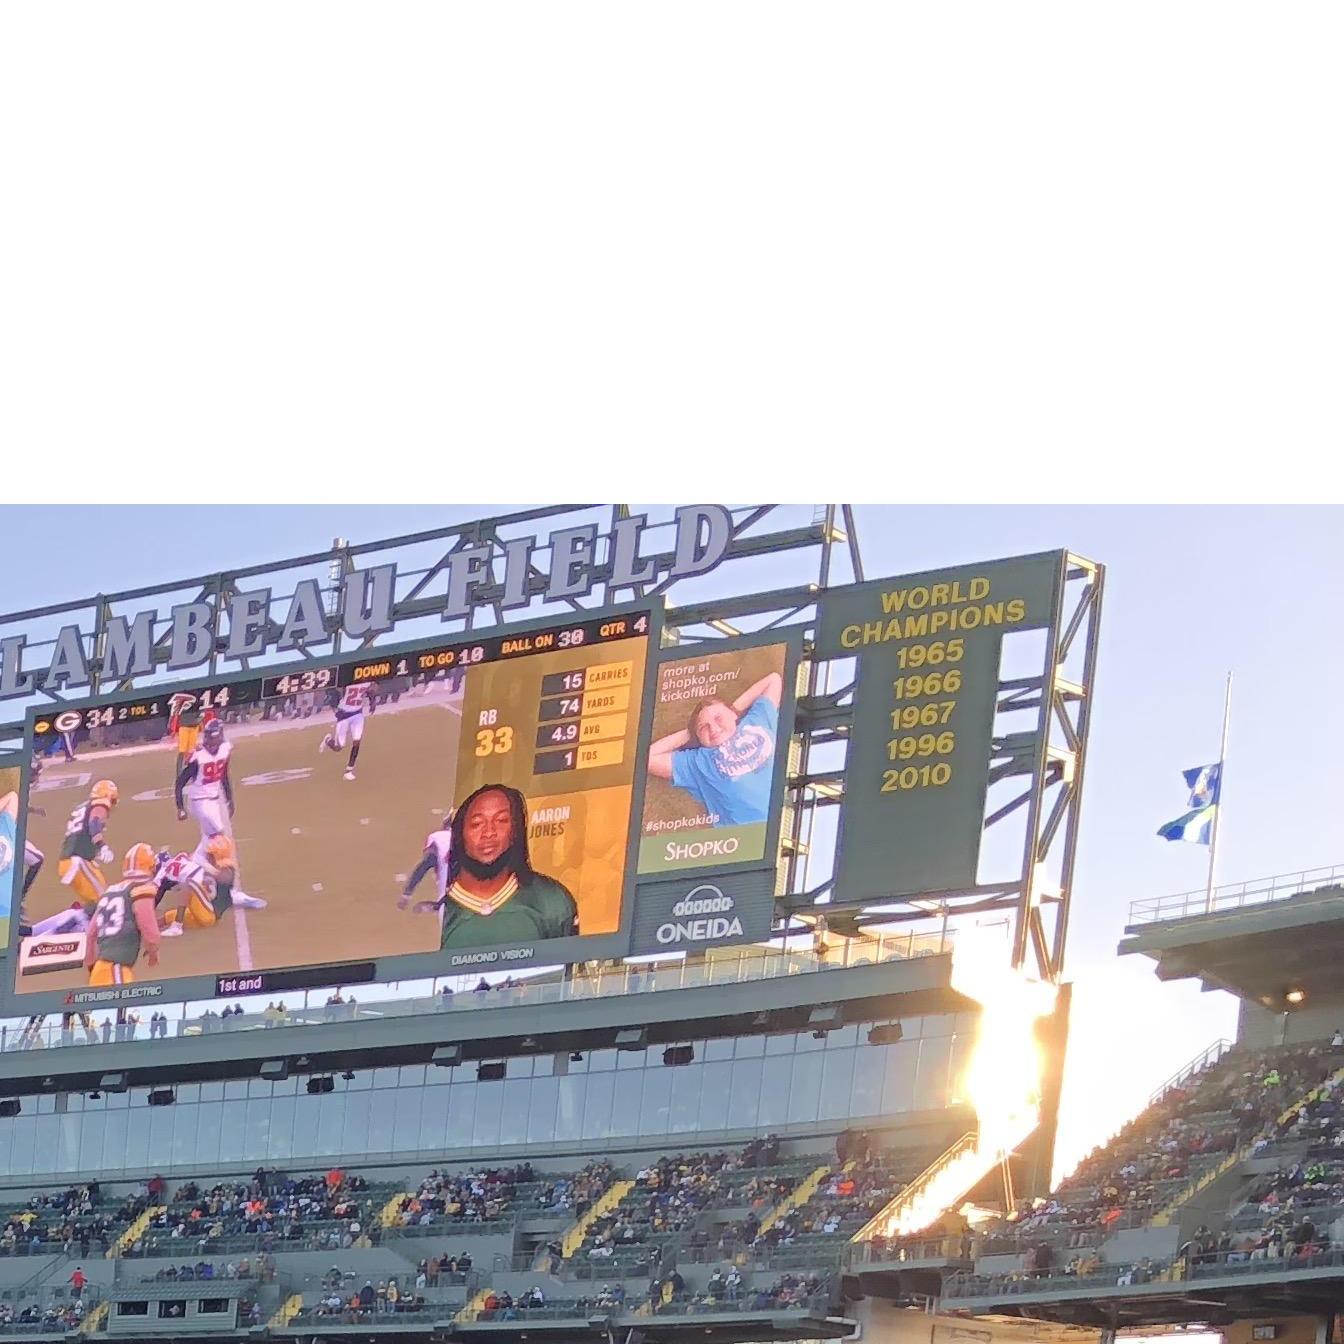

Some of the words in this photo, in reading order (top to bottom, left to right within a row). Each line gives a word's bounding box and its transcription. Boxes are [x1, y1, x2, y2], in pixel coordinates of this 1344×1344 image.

[441, 505, 734, 621] FIELD
[881, 577, 990, 613] WORLD
[600, 621, 625, 637] QTR
[633, 616, 647, 633] 4
[840, 599, 1025, 648] CHAMPIONS
[502, 639, 533, 655] BALL
[535, 634, 553, 648] ON
[896, 639, 964, 669] 1965
[419, 655, 435, 668] TO
[437, 652, 454, 665] GO
[458, 647, 483, 665] 10
[354, 662, 390, 680] DOWN
[396, 659, 409, 676] 1
[563, 673, 583, 690] 15
[589, 668, 628, 683] CARRIES
[664, 665, 694, 677] more
[699, 662, 710, 672] at
[275, 670, 330, 695] 4:39
[662, 684, 717, 702] kickoffkid
[893, 669, 961, 700] 1966
[86, 707, 114, 730] 34
[199, 687, 230, 710] 14
[560, 698, 579, 714] 74
[586, 695, 615, 709] YARDS
[479, 709, 498, 726] RB
[890, 701, 957, 731] 1967
[475, 726, 513, 757] 33
[552, 725, 577, 741] 4.9
[583, 724, 600, 735] AVG
[887, 731, 955, 760] 1996
[564, 752, 573, 766] 1
[880, 762, 952, 793] 2010
[531, 806, 570, 824] AARON
[529, 822, 565, 839] JONES
[656, 917, 743, 944] ONEIDA
[452, 951, 497, 966] DIAMOND
[500, 948, 534, 960] VISION
[74, 991, 119, 1003] MITSUBISHI
[121, 986, 162, 999] ELECTRIC
[219, 978, 237, 993] 1st
[239, 976, 262, 990] and
